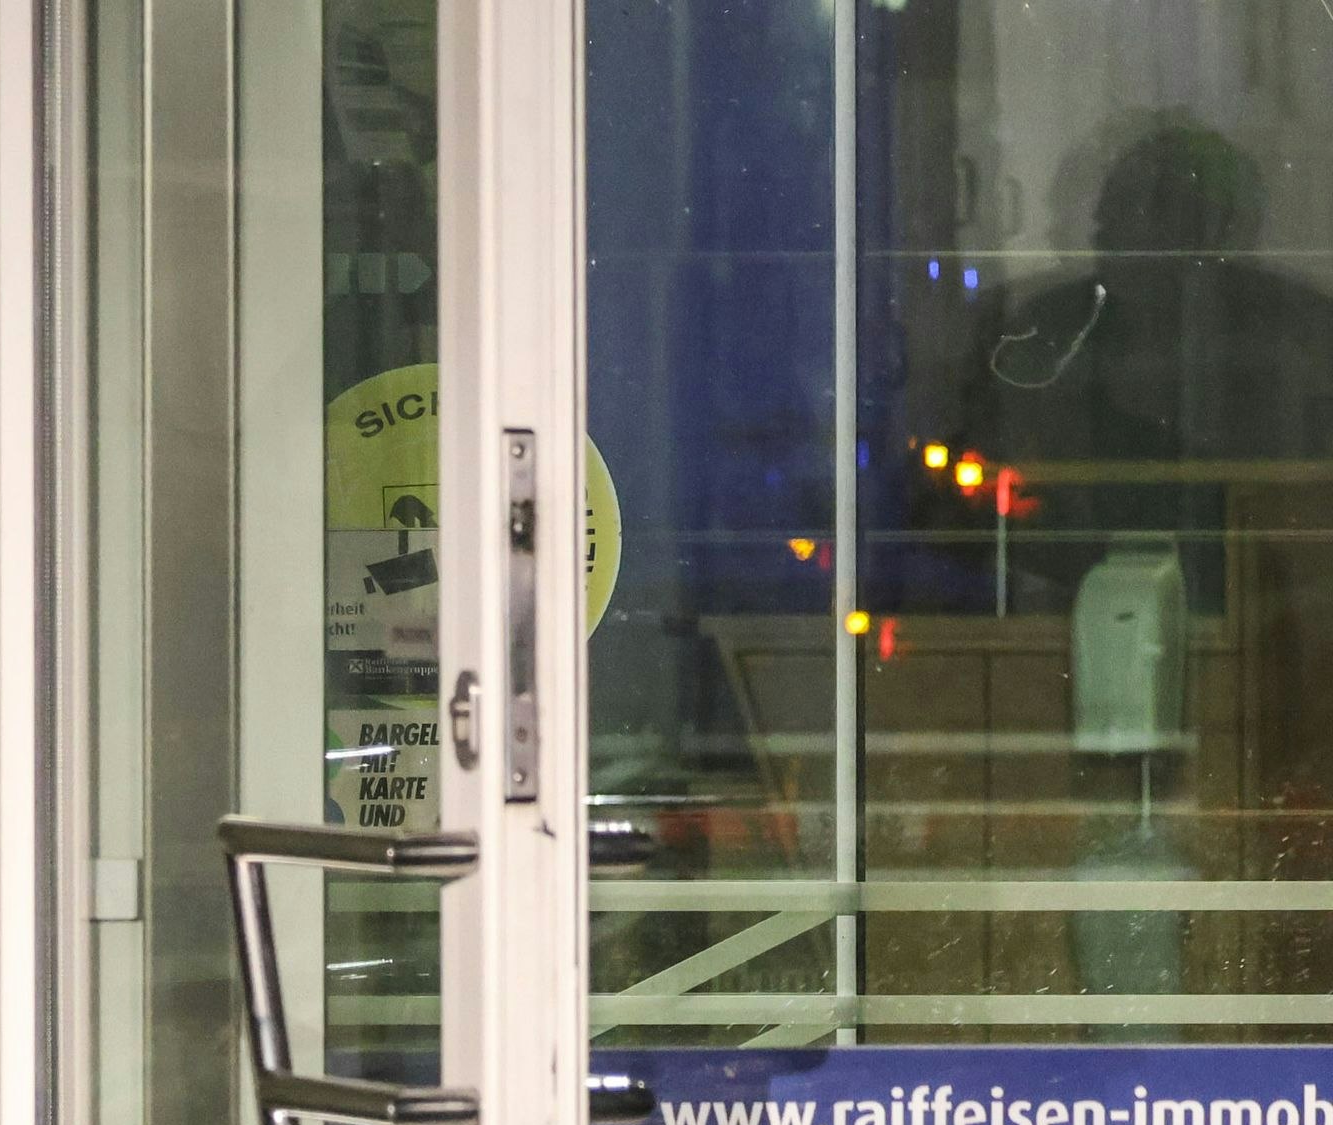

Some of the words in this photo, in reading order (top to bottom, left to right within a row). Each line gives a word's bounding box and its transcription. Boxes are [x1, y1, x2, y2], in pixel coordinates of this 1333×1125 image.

[359, 723, 439, 746] BARGEL
[360, 749, 400, 773] MIT
[359, 777, 427, 800] KARTE
[359, 804, 405, 827] UND
